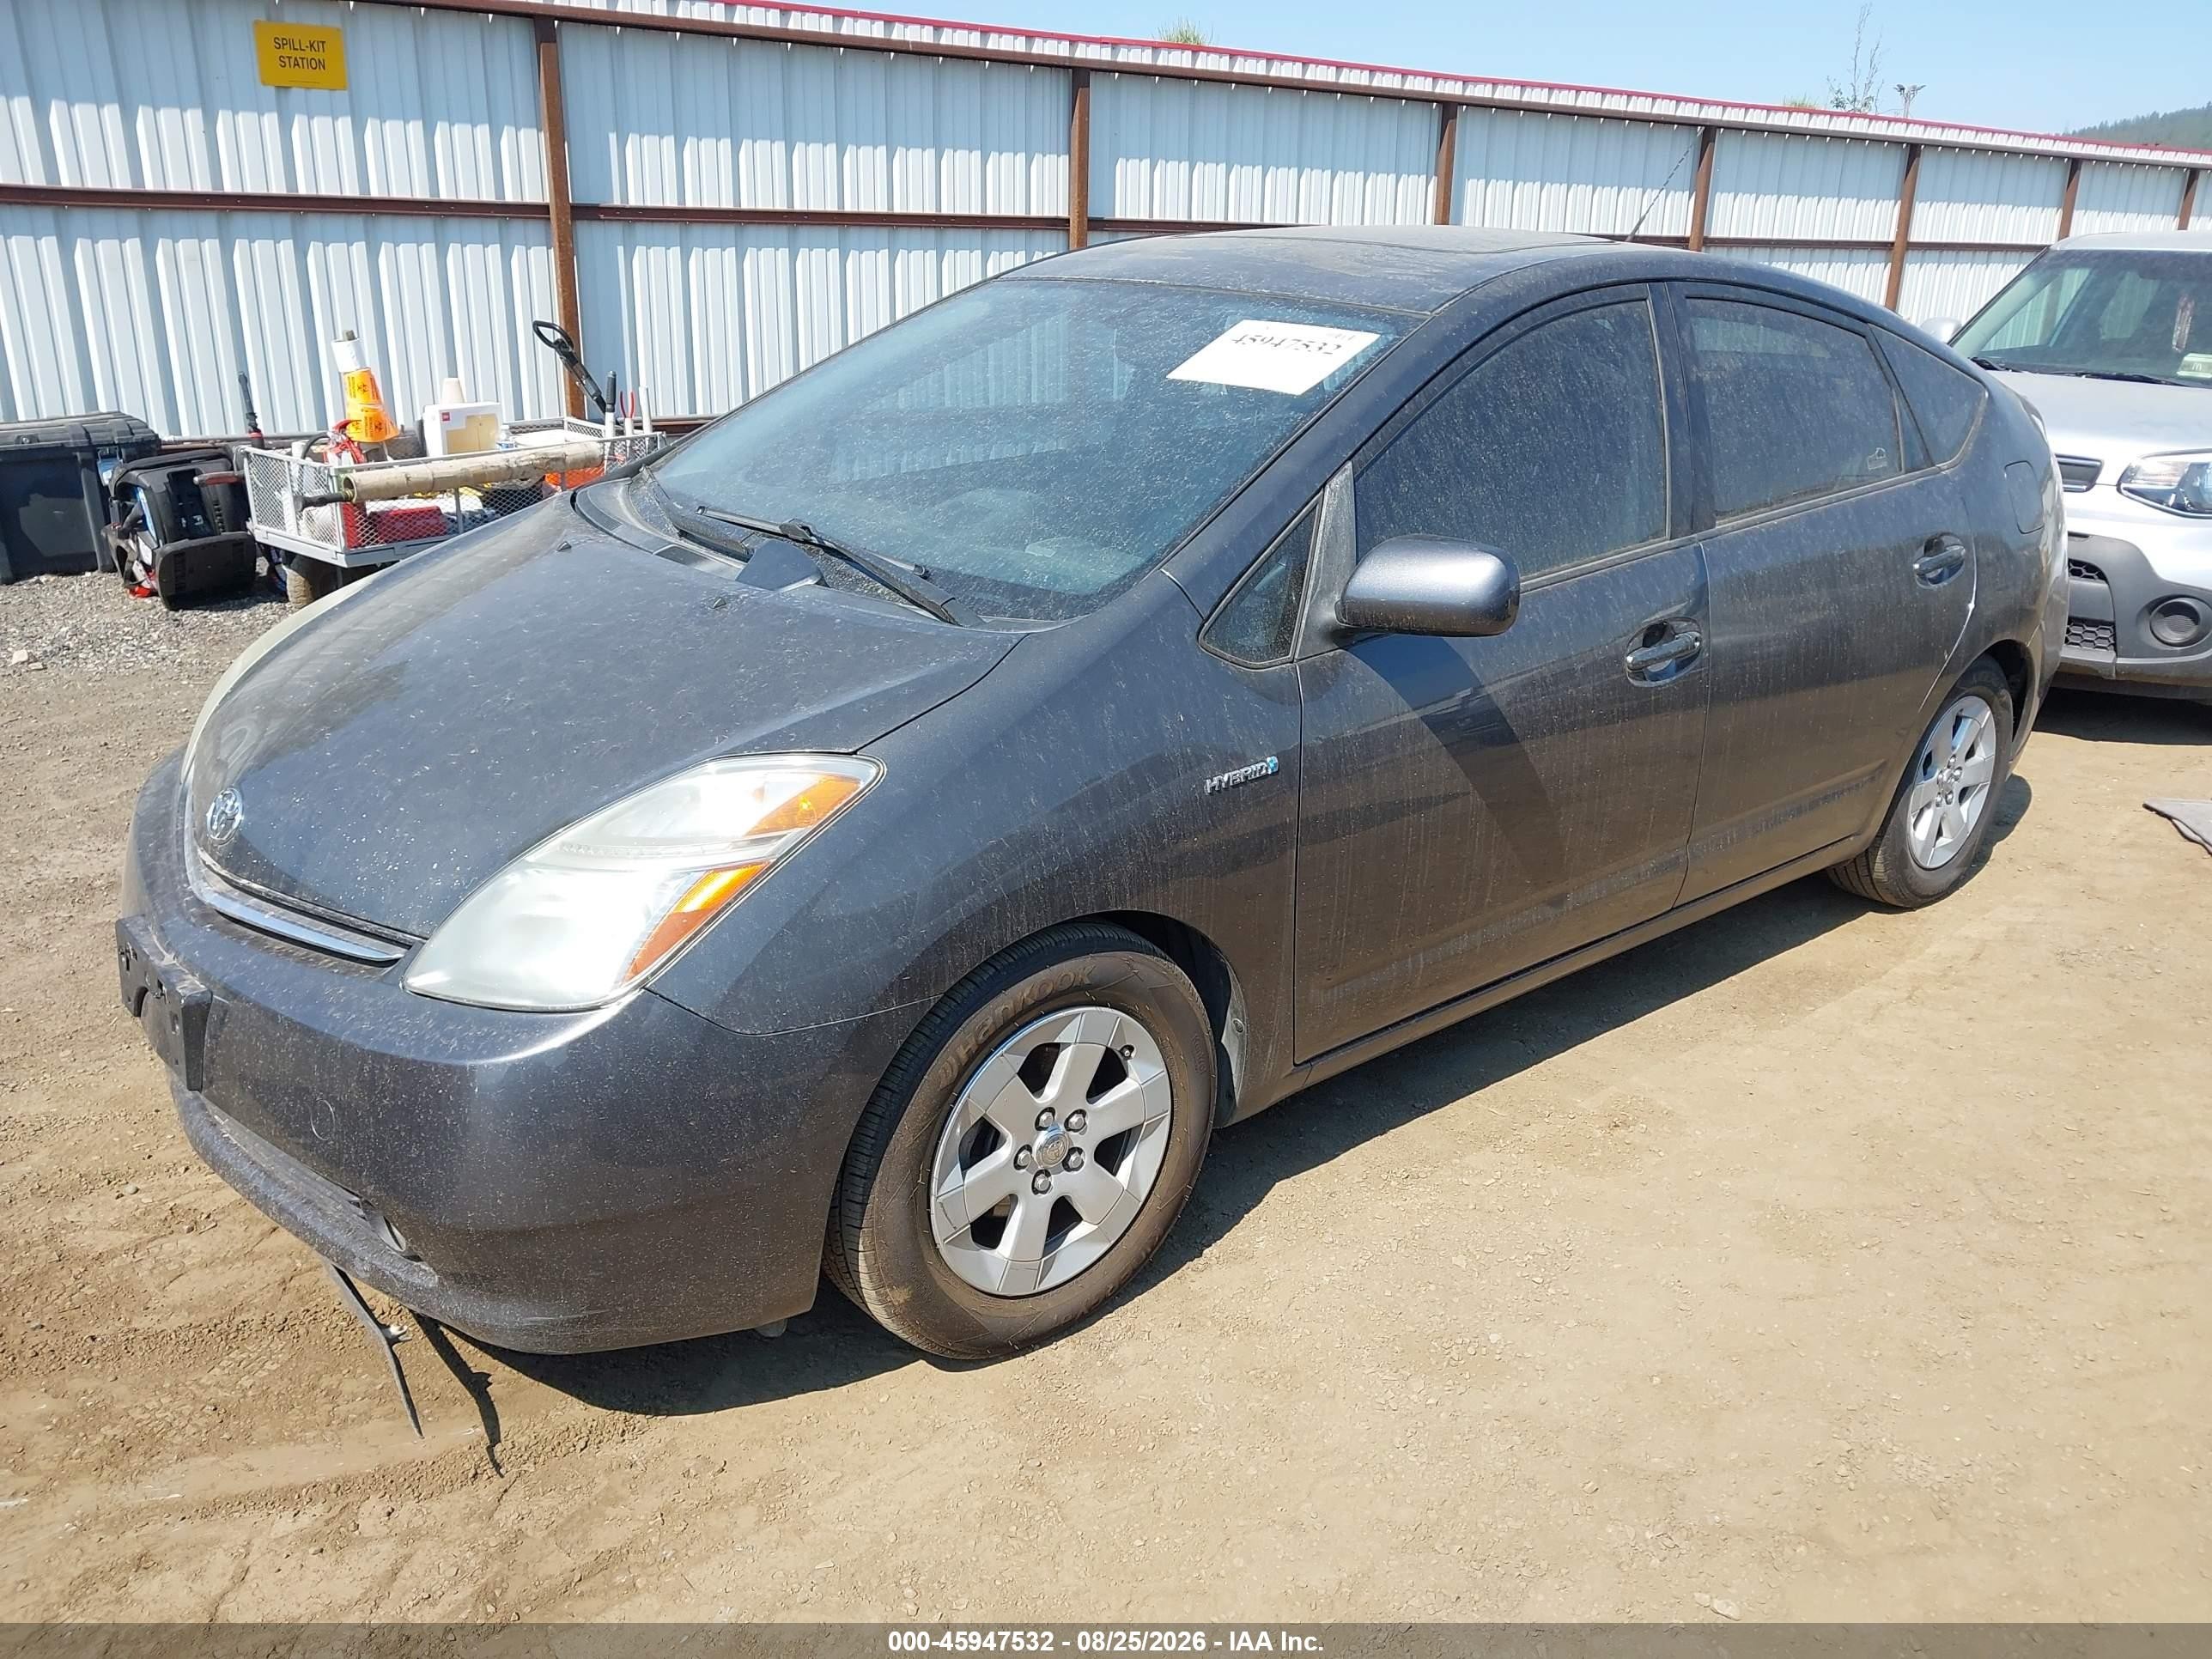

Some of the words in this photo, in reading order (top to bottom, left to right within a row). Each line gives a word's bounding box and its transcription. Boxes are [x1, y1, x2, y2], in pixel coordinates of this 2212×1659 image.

[273, 36, 326, 53] SPILL-KIT
[278, 55, 326, 70] STATION
[1205, 761, 1268, 794] HYBRID
